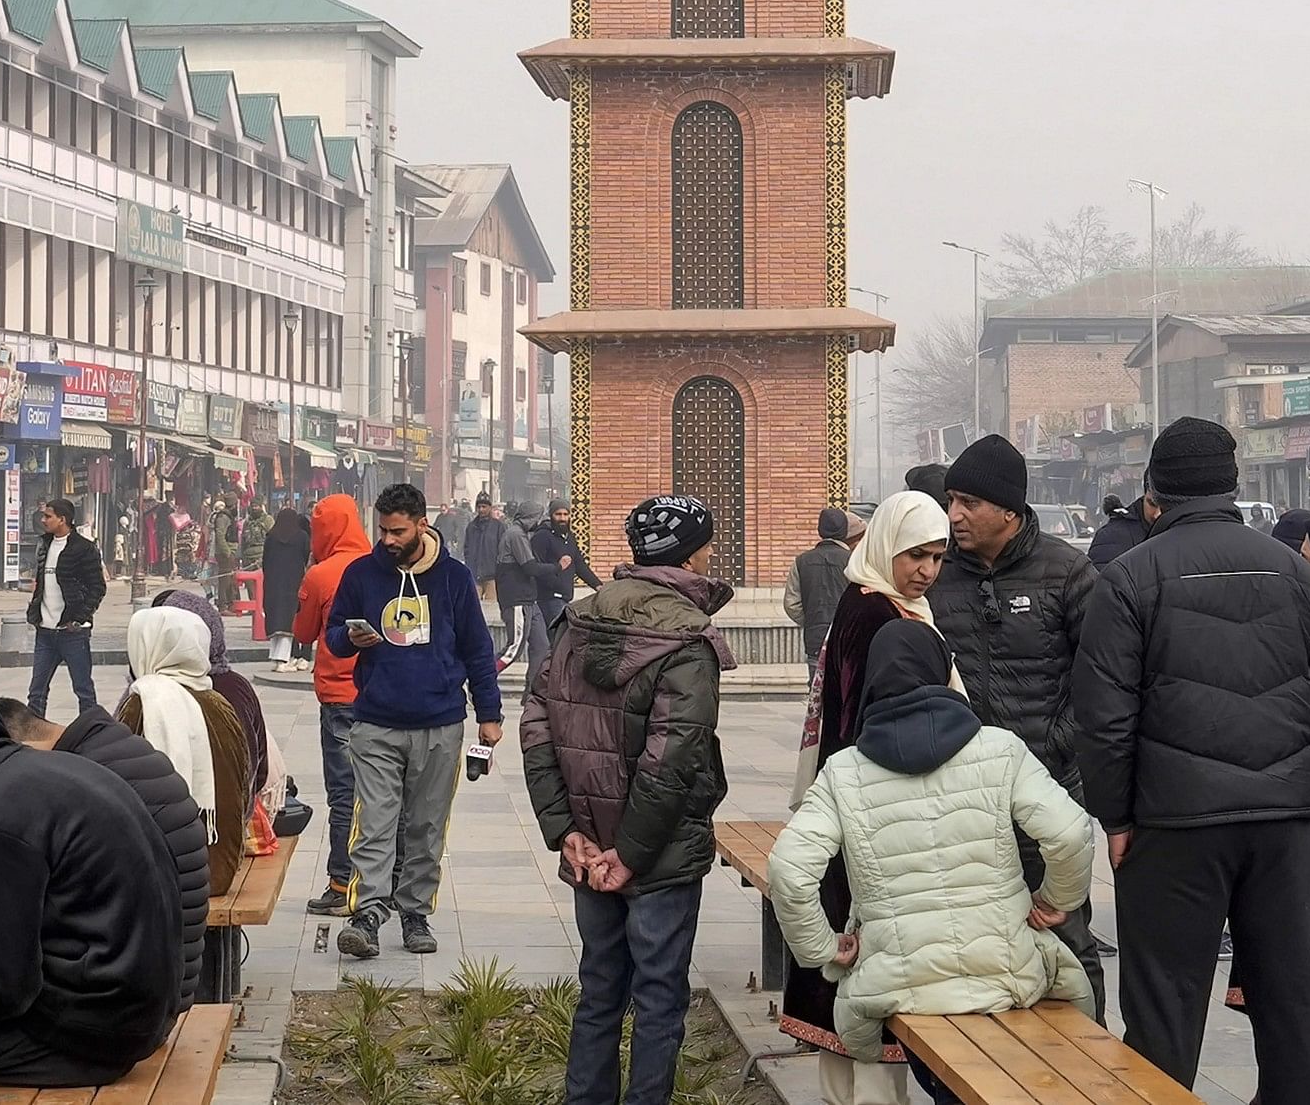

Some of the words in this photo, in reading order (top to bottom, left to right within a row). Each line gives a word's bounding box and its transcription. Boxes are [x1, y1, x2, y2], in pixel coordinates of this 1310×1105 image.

[151, 210, 173, 234] HOTEL
[140, 230, 160, 258] LALA
[161, 235, 183, 263] RUKH
[23, 383, 55, 402] SAMSUNG
[27, 407, 51, 430] Galaxy
